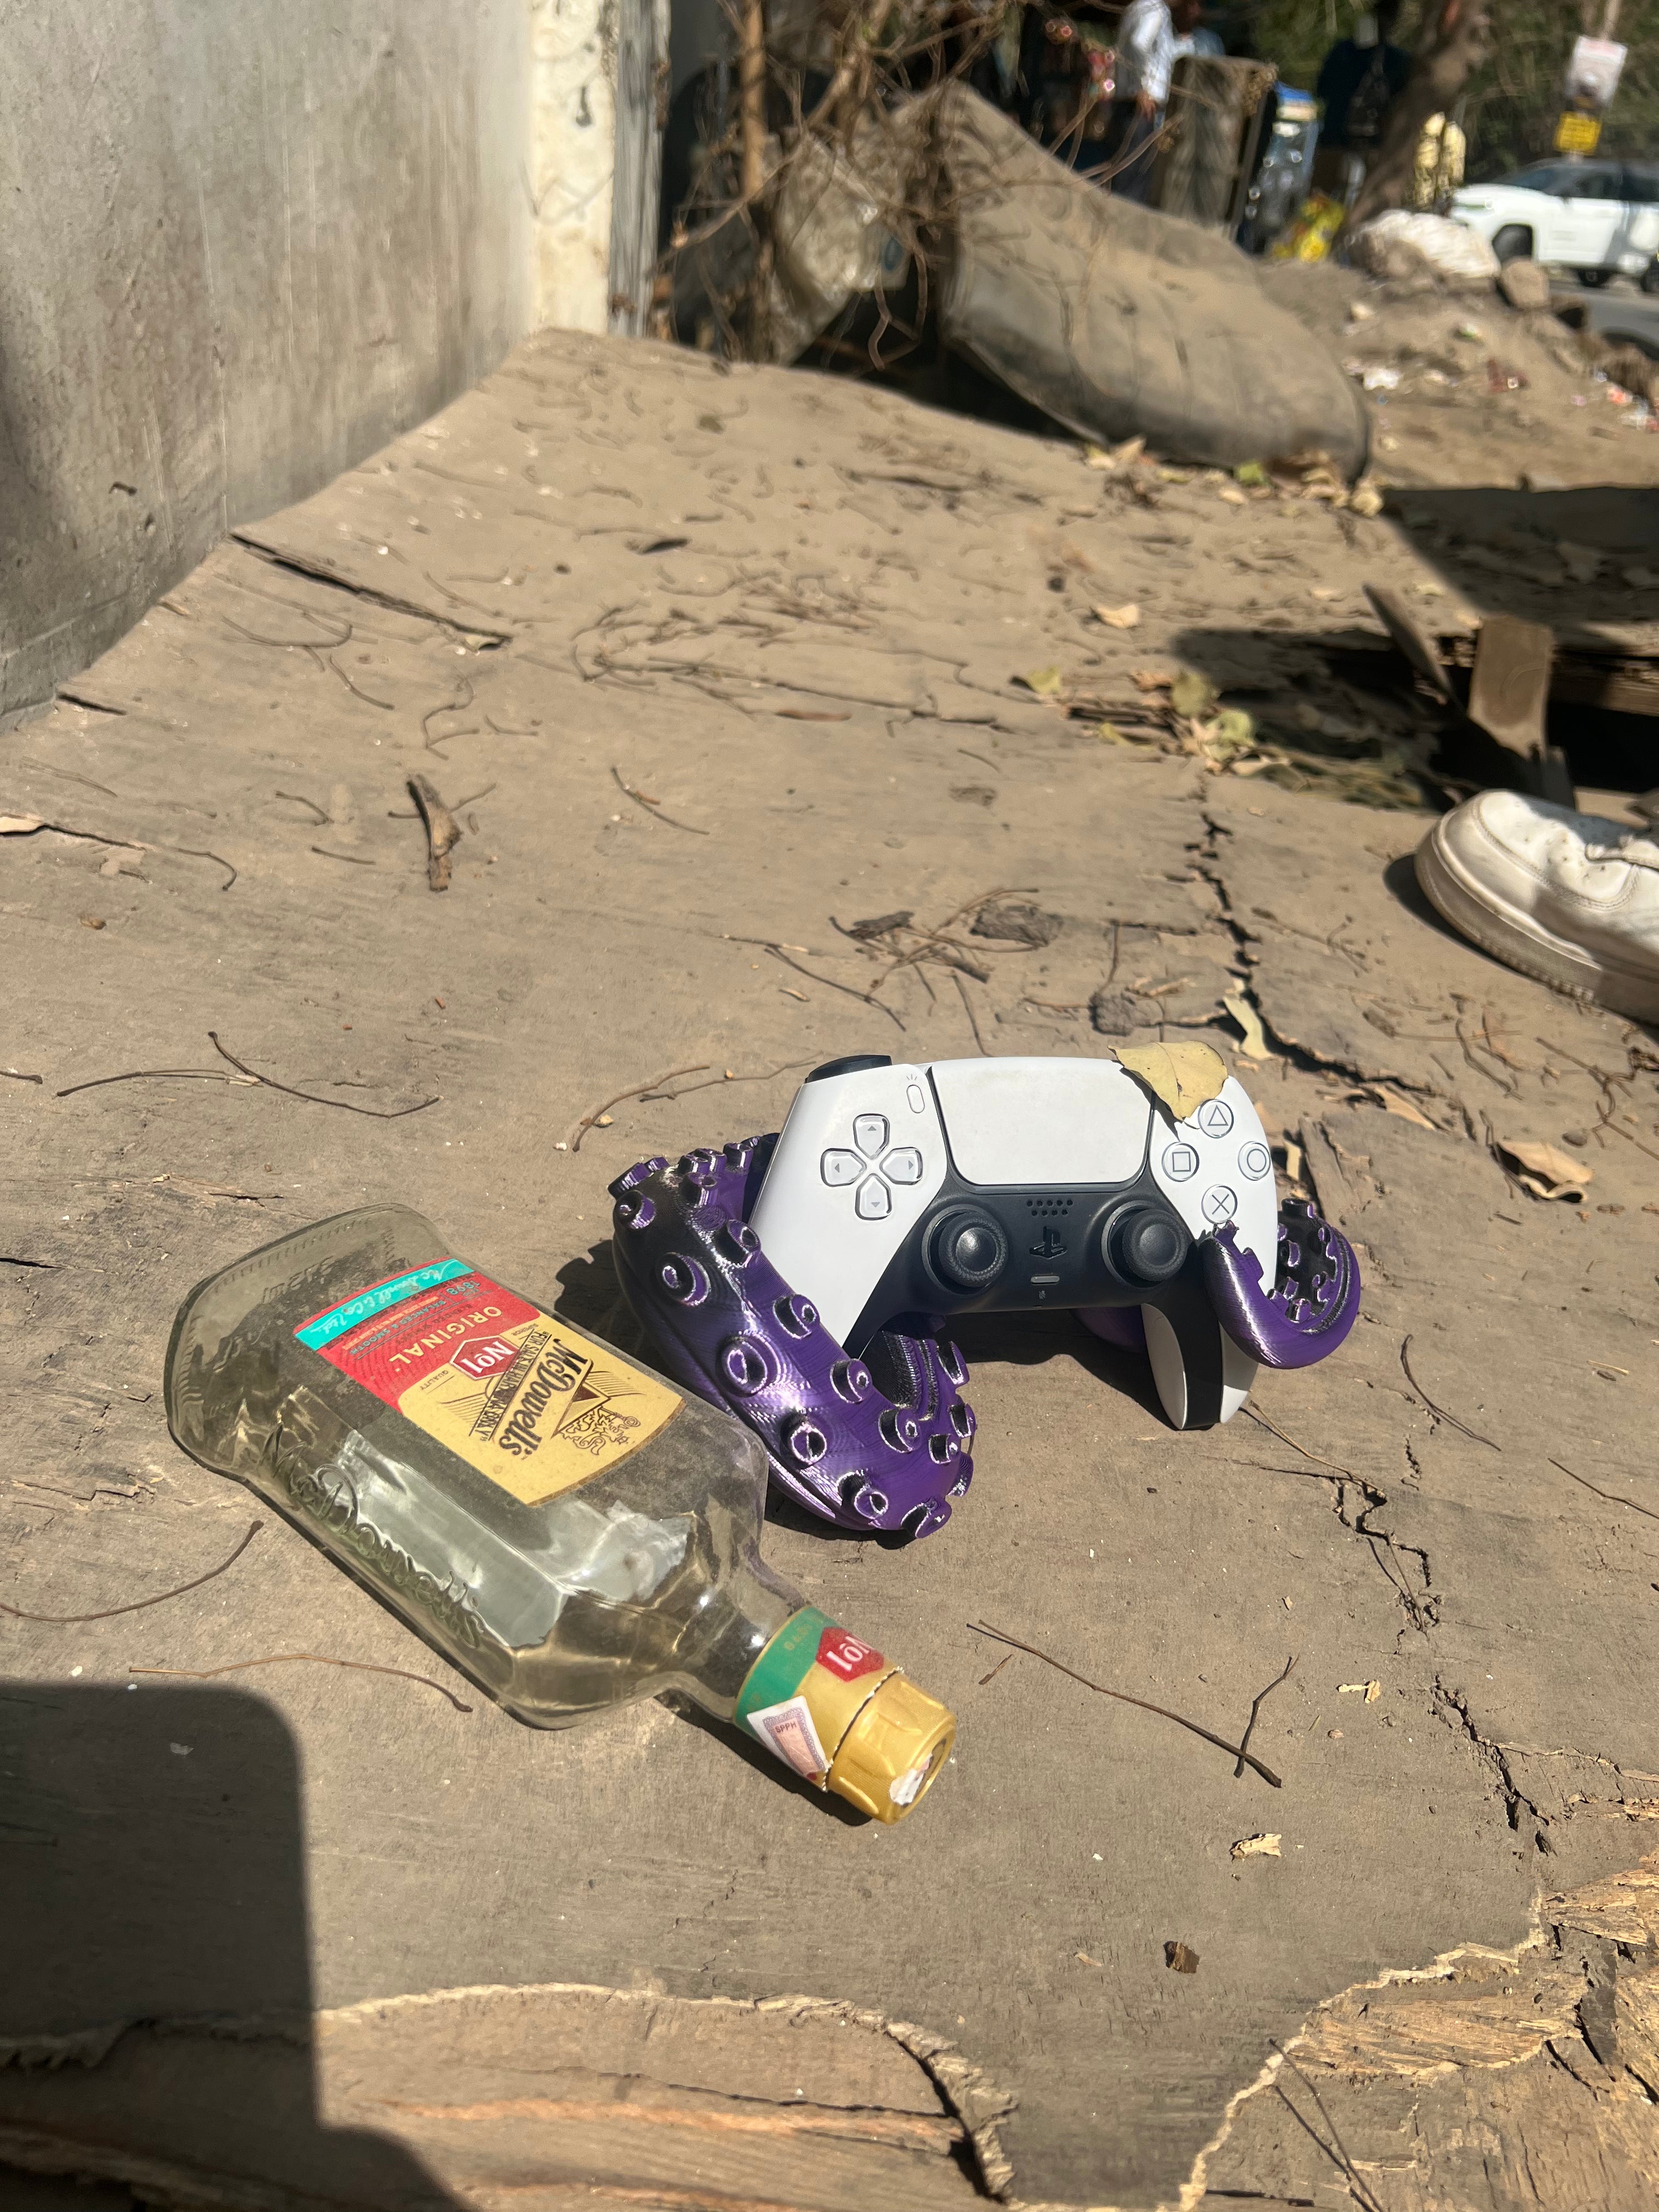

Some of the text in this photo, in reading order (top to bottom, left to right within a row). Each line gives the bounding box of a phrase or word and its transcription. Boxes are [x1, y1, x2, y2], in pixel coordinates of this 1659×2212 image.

[446, 1280, 480, 1295] 1898
[399, 1300, 446, 1325] BALANCED
[349, 1328, 391, 1355] SMOOTH
[388, 1306, 503, 1364] ORIGINAL
[420, 1369, 449, 1391] QUALITY
[775, 1720, 798, 1734] SPPH
